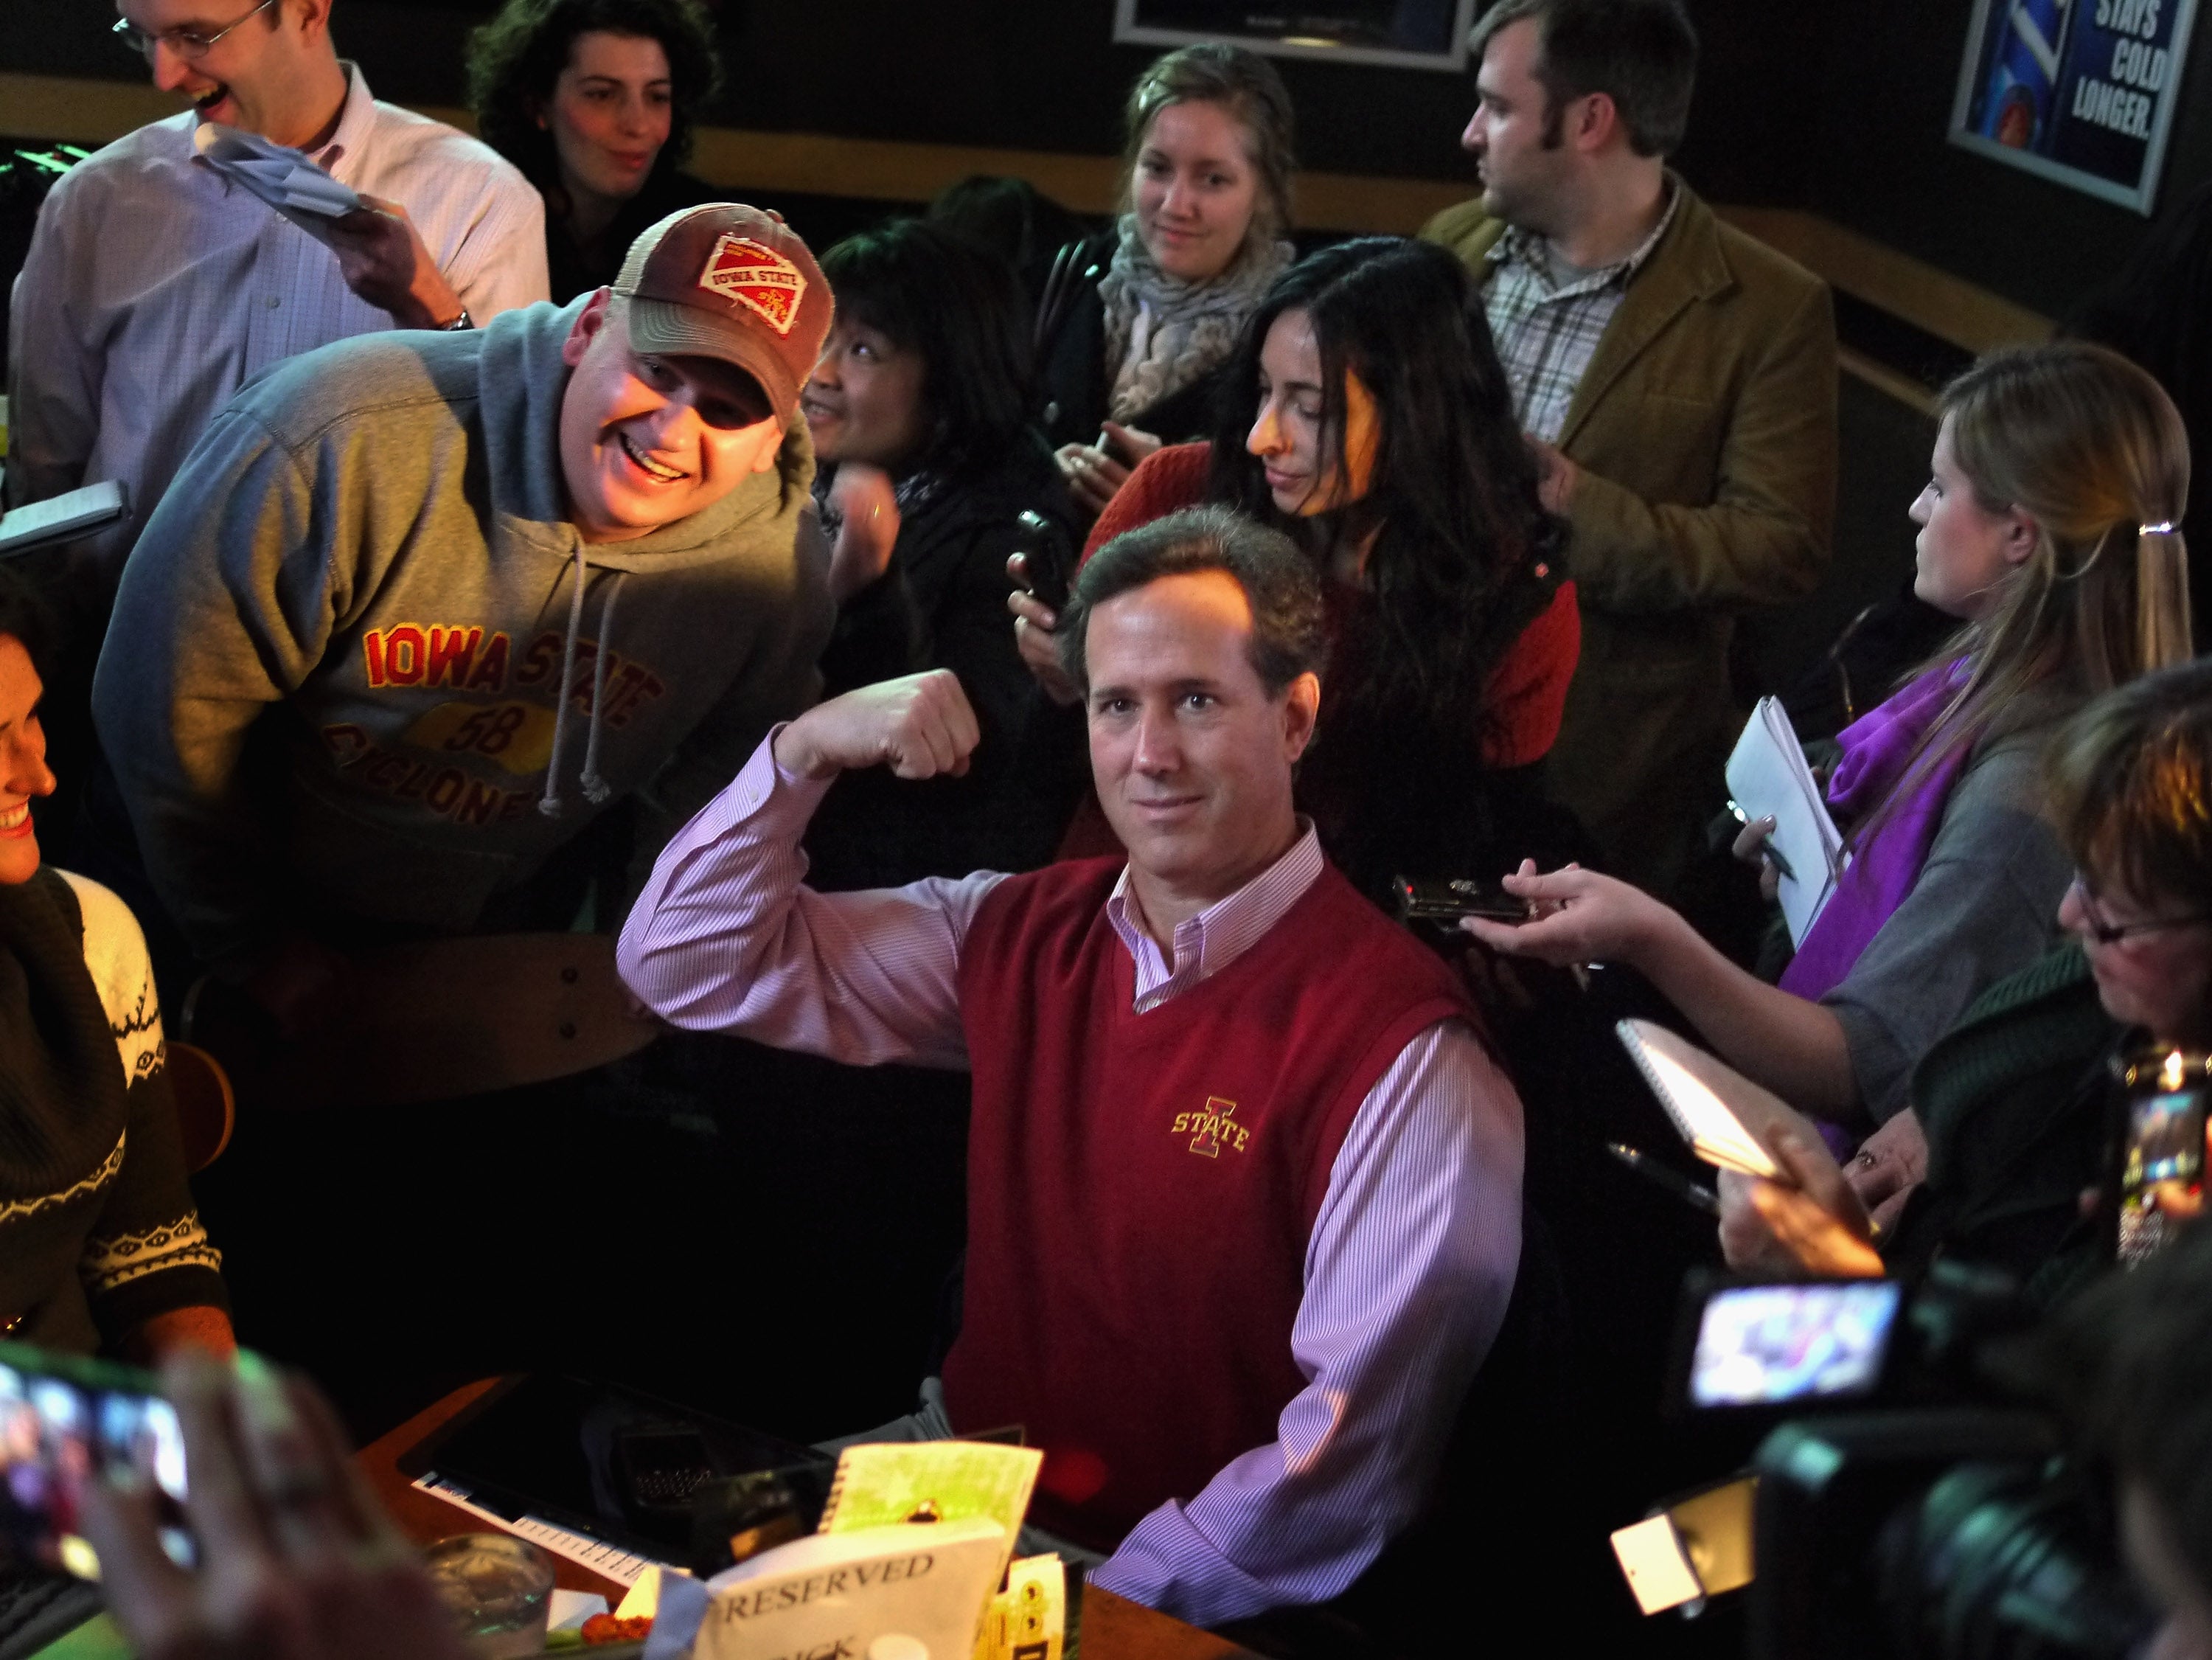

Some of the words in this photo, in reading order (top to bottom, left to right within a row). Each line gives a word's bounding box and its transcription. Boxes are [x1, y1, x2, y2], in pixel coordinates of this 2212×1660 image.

[2095, 0, 2161, 39] STAYS
[2110, 38, 2168, 91] COLD
[2072, 76, 2151, 140] LONGER.
[712, 271, 755, 285] IOWA
[759, 270, 797, 285] STATE
[364, 622, 511, 695] IOWA
[445, 705, 526, 754] 58
[1171, 1112, 1250, 1153] STATE
[723, 1553, 935, 1623] RESERVED
